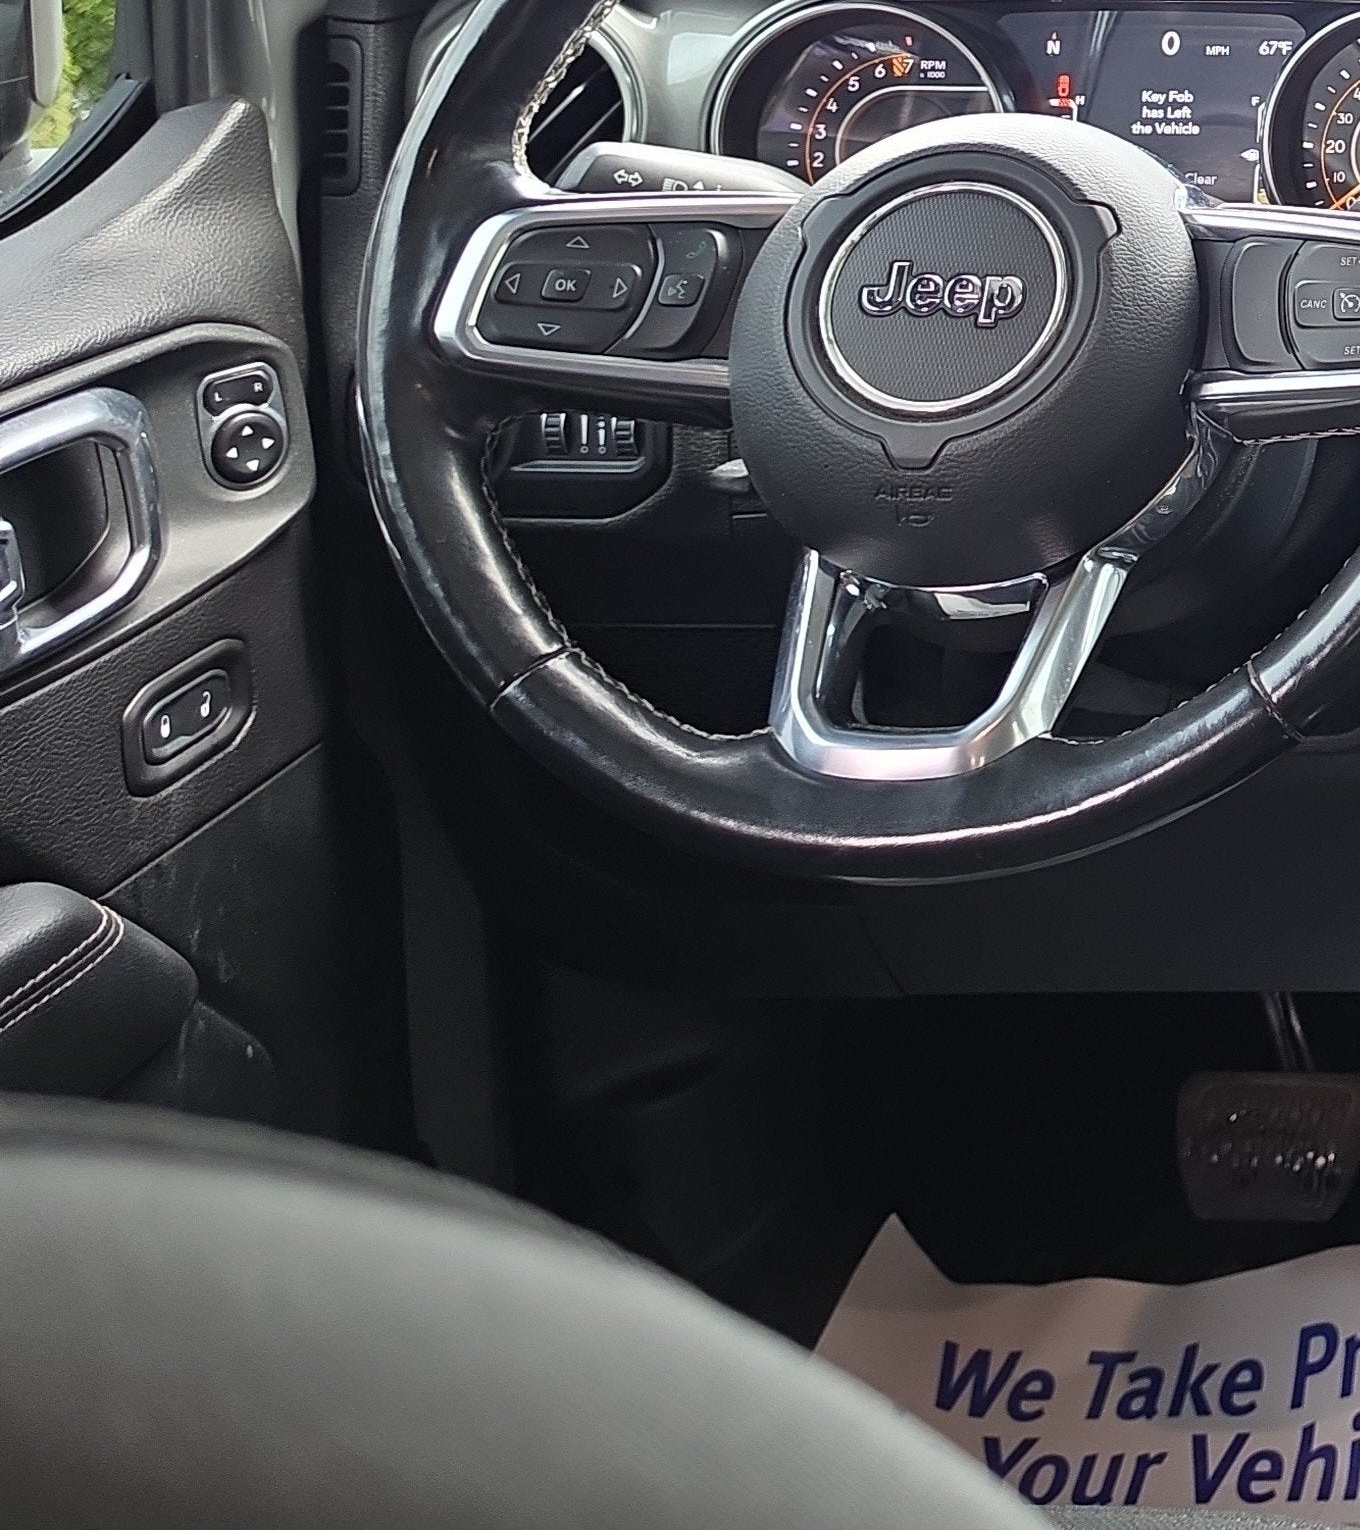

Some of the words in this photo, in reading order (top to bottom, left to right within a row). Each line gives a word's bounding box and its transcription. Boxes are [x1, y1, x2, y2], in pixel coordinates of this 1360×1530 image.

[1046, 40, 1061, 55] N
[1161, 30, 1181, 56] 0
[1205, 45, 1230, 56] MPH
[874, 62, 887, 79] 6
[919, 59, 947, 71] RPM
[847, 76, 861, 92] 5
[1141, 90, 1167, 105] Key
[1168, 89, 1194, 103] Fob
[825, 97, 839, 113] 4
[1142, 105, 1165, 119] has
[1167, 105, 1192, 119] Left
[1336, 112, 1354, 125] 30
[814, 123, 827, 140] 3
[1131, 121, 1153, 135] the
[1155, 121, 1200, 135] Vehicle
[1325, 139, 1346, 154] 20
[812, 151, 825, 168] 2
[1184, 172, 1218, 186] Clear
[1332, 171, 1346, 183] 10
[554, 278, 576, 292] OK
[860, 260, 1027, 328] Jeep
[1300, 299, 1327, 309] CANC
[252, 381, 264, 392] R
[213, 391, 224, 402] L
[873, 485, 955, 502] AIRBAG
[934, 1339, 1057, 1422] We
[1084, 1343, 1264, 1421] Take
[980, 1435, 1168, 1506] Your
